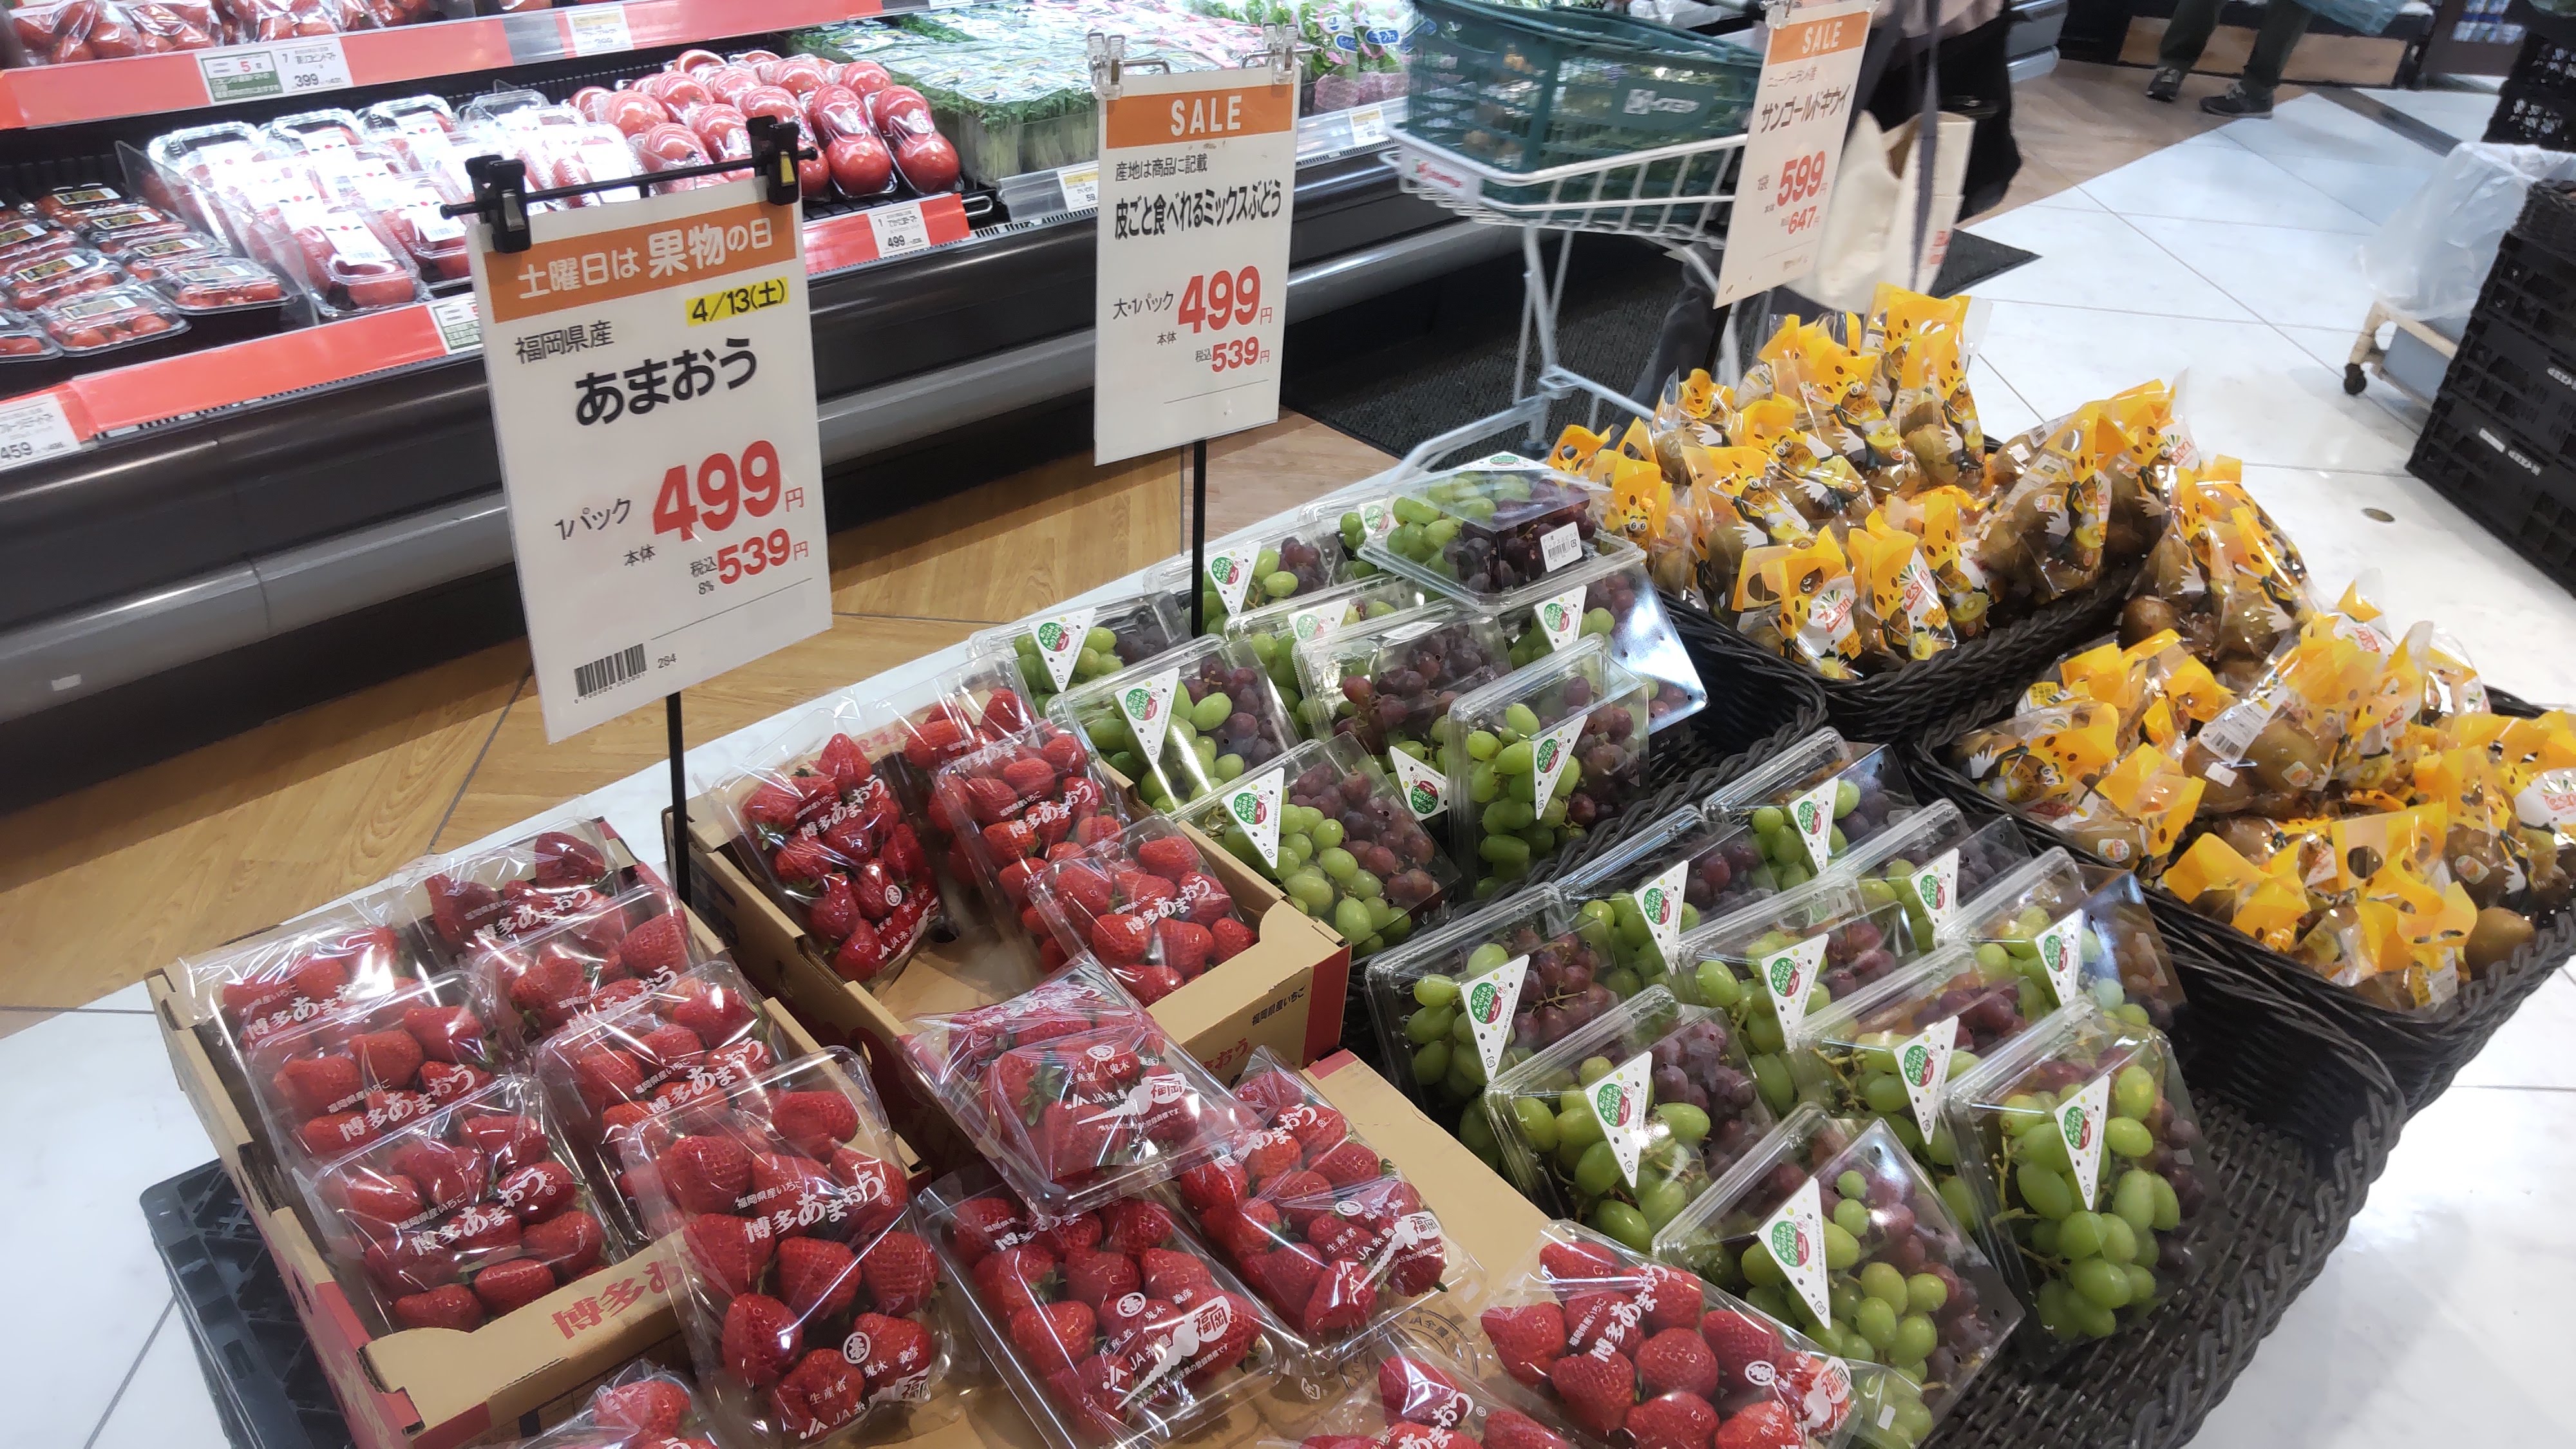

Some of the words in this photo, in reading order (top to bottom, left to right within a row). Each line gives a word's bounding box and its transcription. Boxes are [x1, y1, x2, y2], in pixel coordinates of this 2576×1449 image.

[1802, 21, 1843, 54] SALE
[295, 73, 319, 87] 399
[1171, 95, 1242, 137] SALE
[1115, 153, 1208, 182] 産地は商品に記載
[1115, 179, 1282, 240] 皮ごと食べれるミックスぶどう
[888, 235, 905, 248] 499
[690, 279, 788, 323] 4/13(土)
[514, 319, 615, 364] 福岡県産
[1157, 330, 1177, 345] 本体
[574, 338, 758, 426] あまおう
[554, 498, 632, 540] 1パック
[623, 545, 656, 567] 本体
[689, 556, 718, 576] 税込
[800, 774, 886, 842] 博多あまおう
[1009, 780, 1093, 838] 博多あまおう
[1125, 875, 1211, 935] 博多あまおう
[1251, 984, 1307, 1027] 福岡県産いちご
[327, 1078, 391, 1113] 福岡県産いちご
[646, 1037, 765, 1116] 博多あまおう
[339, 1063, 475, 1142] 博多あまおう
[398, 1191, 467, 1231] 福岡県産いちご
[410, 1168, 549, 1257] 博多あまおう
[735, 1179, 802, 1209] 福岡県産いちご
[744, 1170, 885, 1243] 博多あまおう
[1327, 1227, 1358, 1255] 生産者
[1193, 1303, 1227, 1338] 福岡
[1588, 1262, 1671, 1363] 博多あまおう
